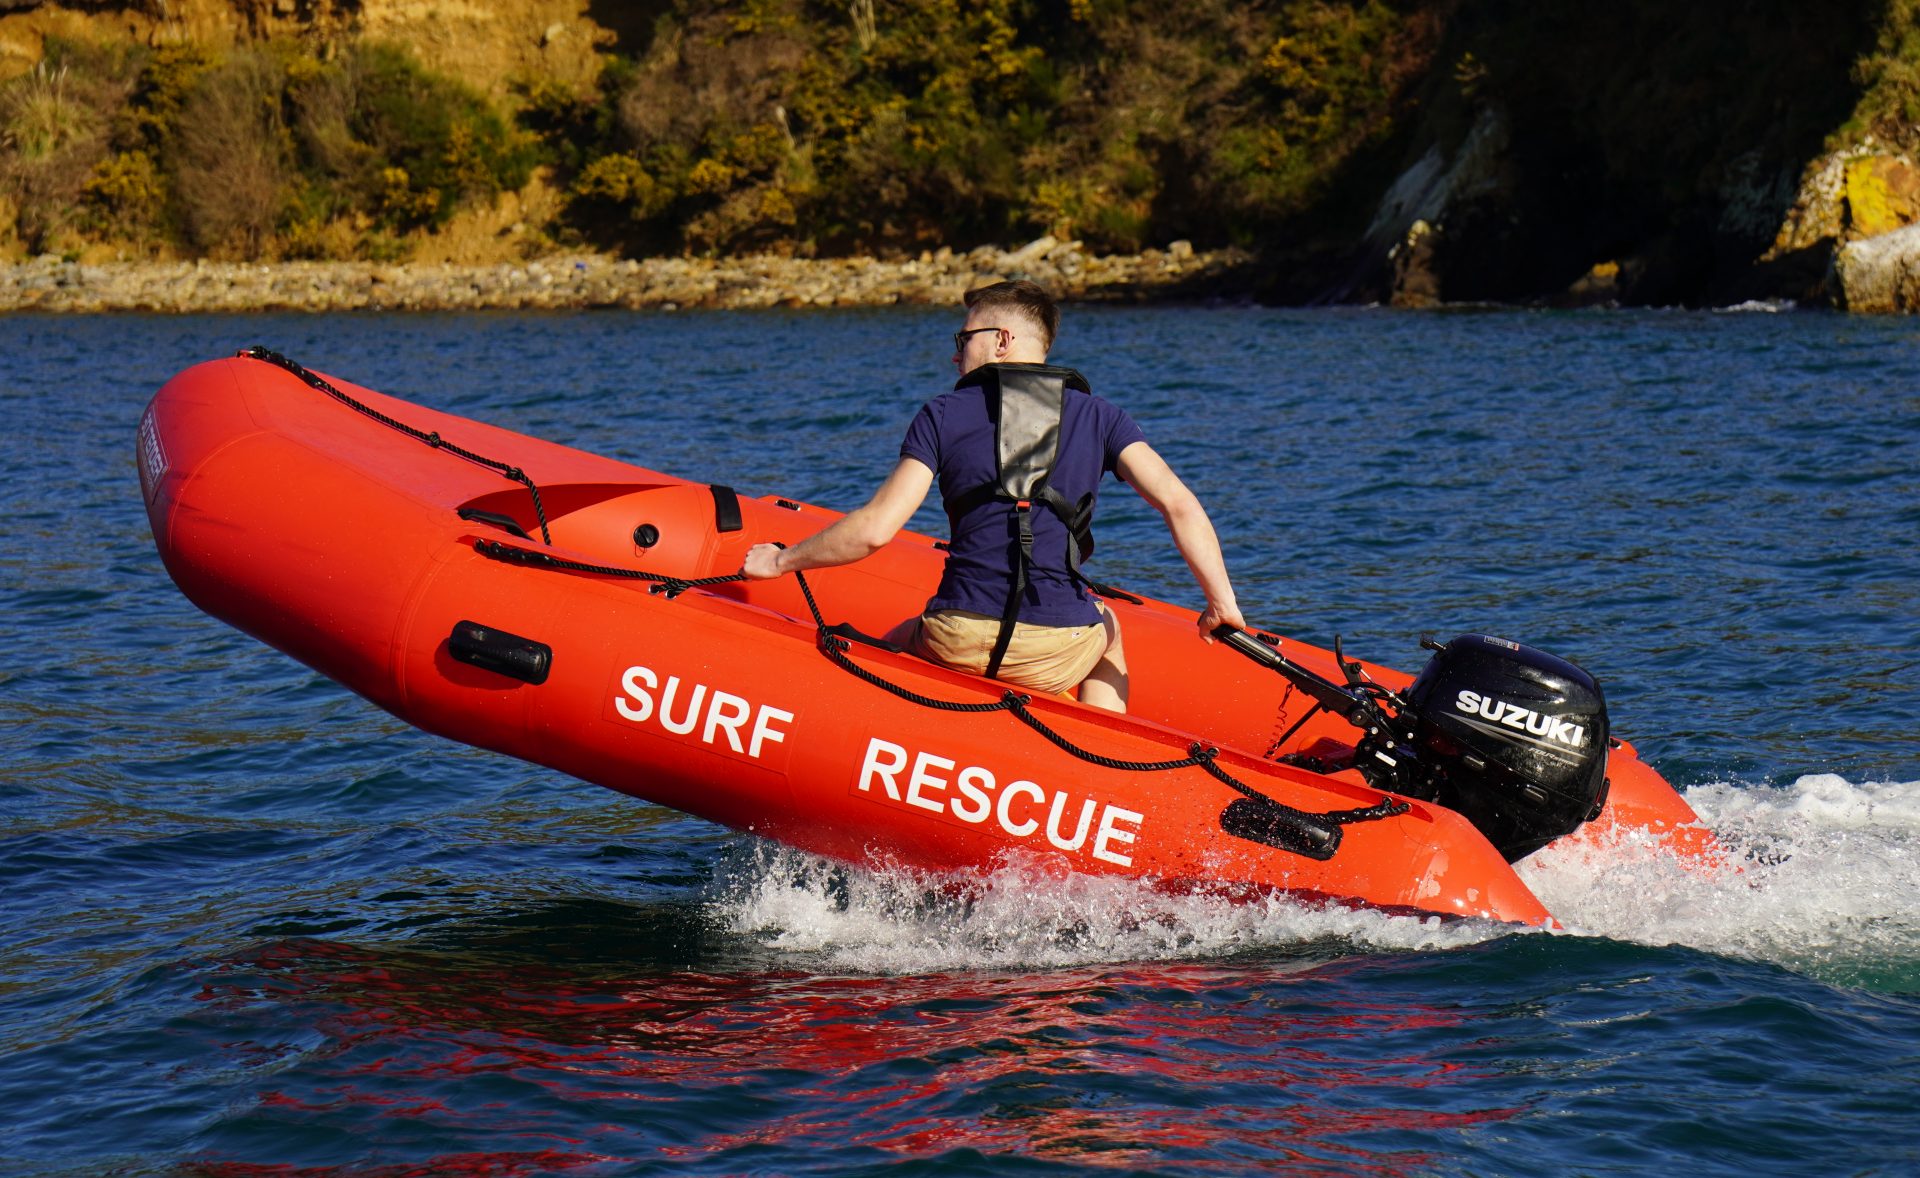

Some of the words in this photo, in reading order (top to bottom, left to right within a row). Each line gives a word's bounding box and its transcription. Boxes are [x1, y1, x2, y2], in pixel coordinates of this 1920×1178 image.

[614, 665, 795, 758] SURF
[1455, 689, 1585, 747] SUZUKI
[858, 737, 1144, 868] RESCUE
